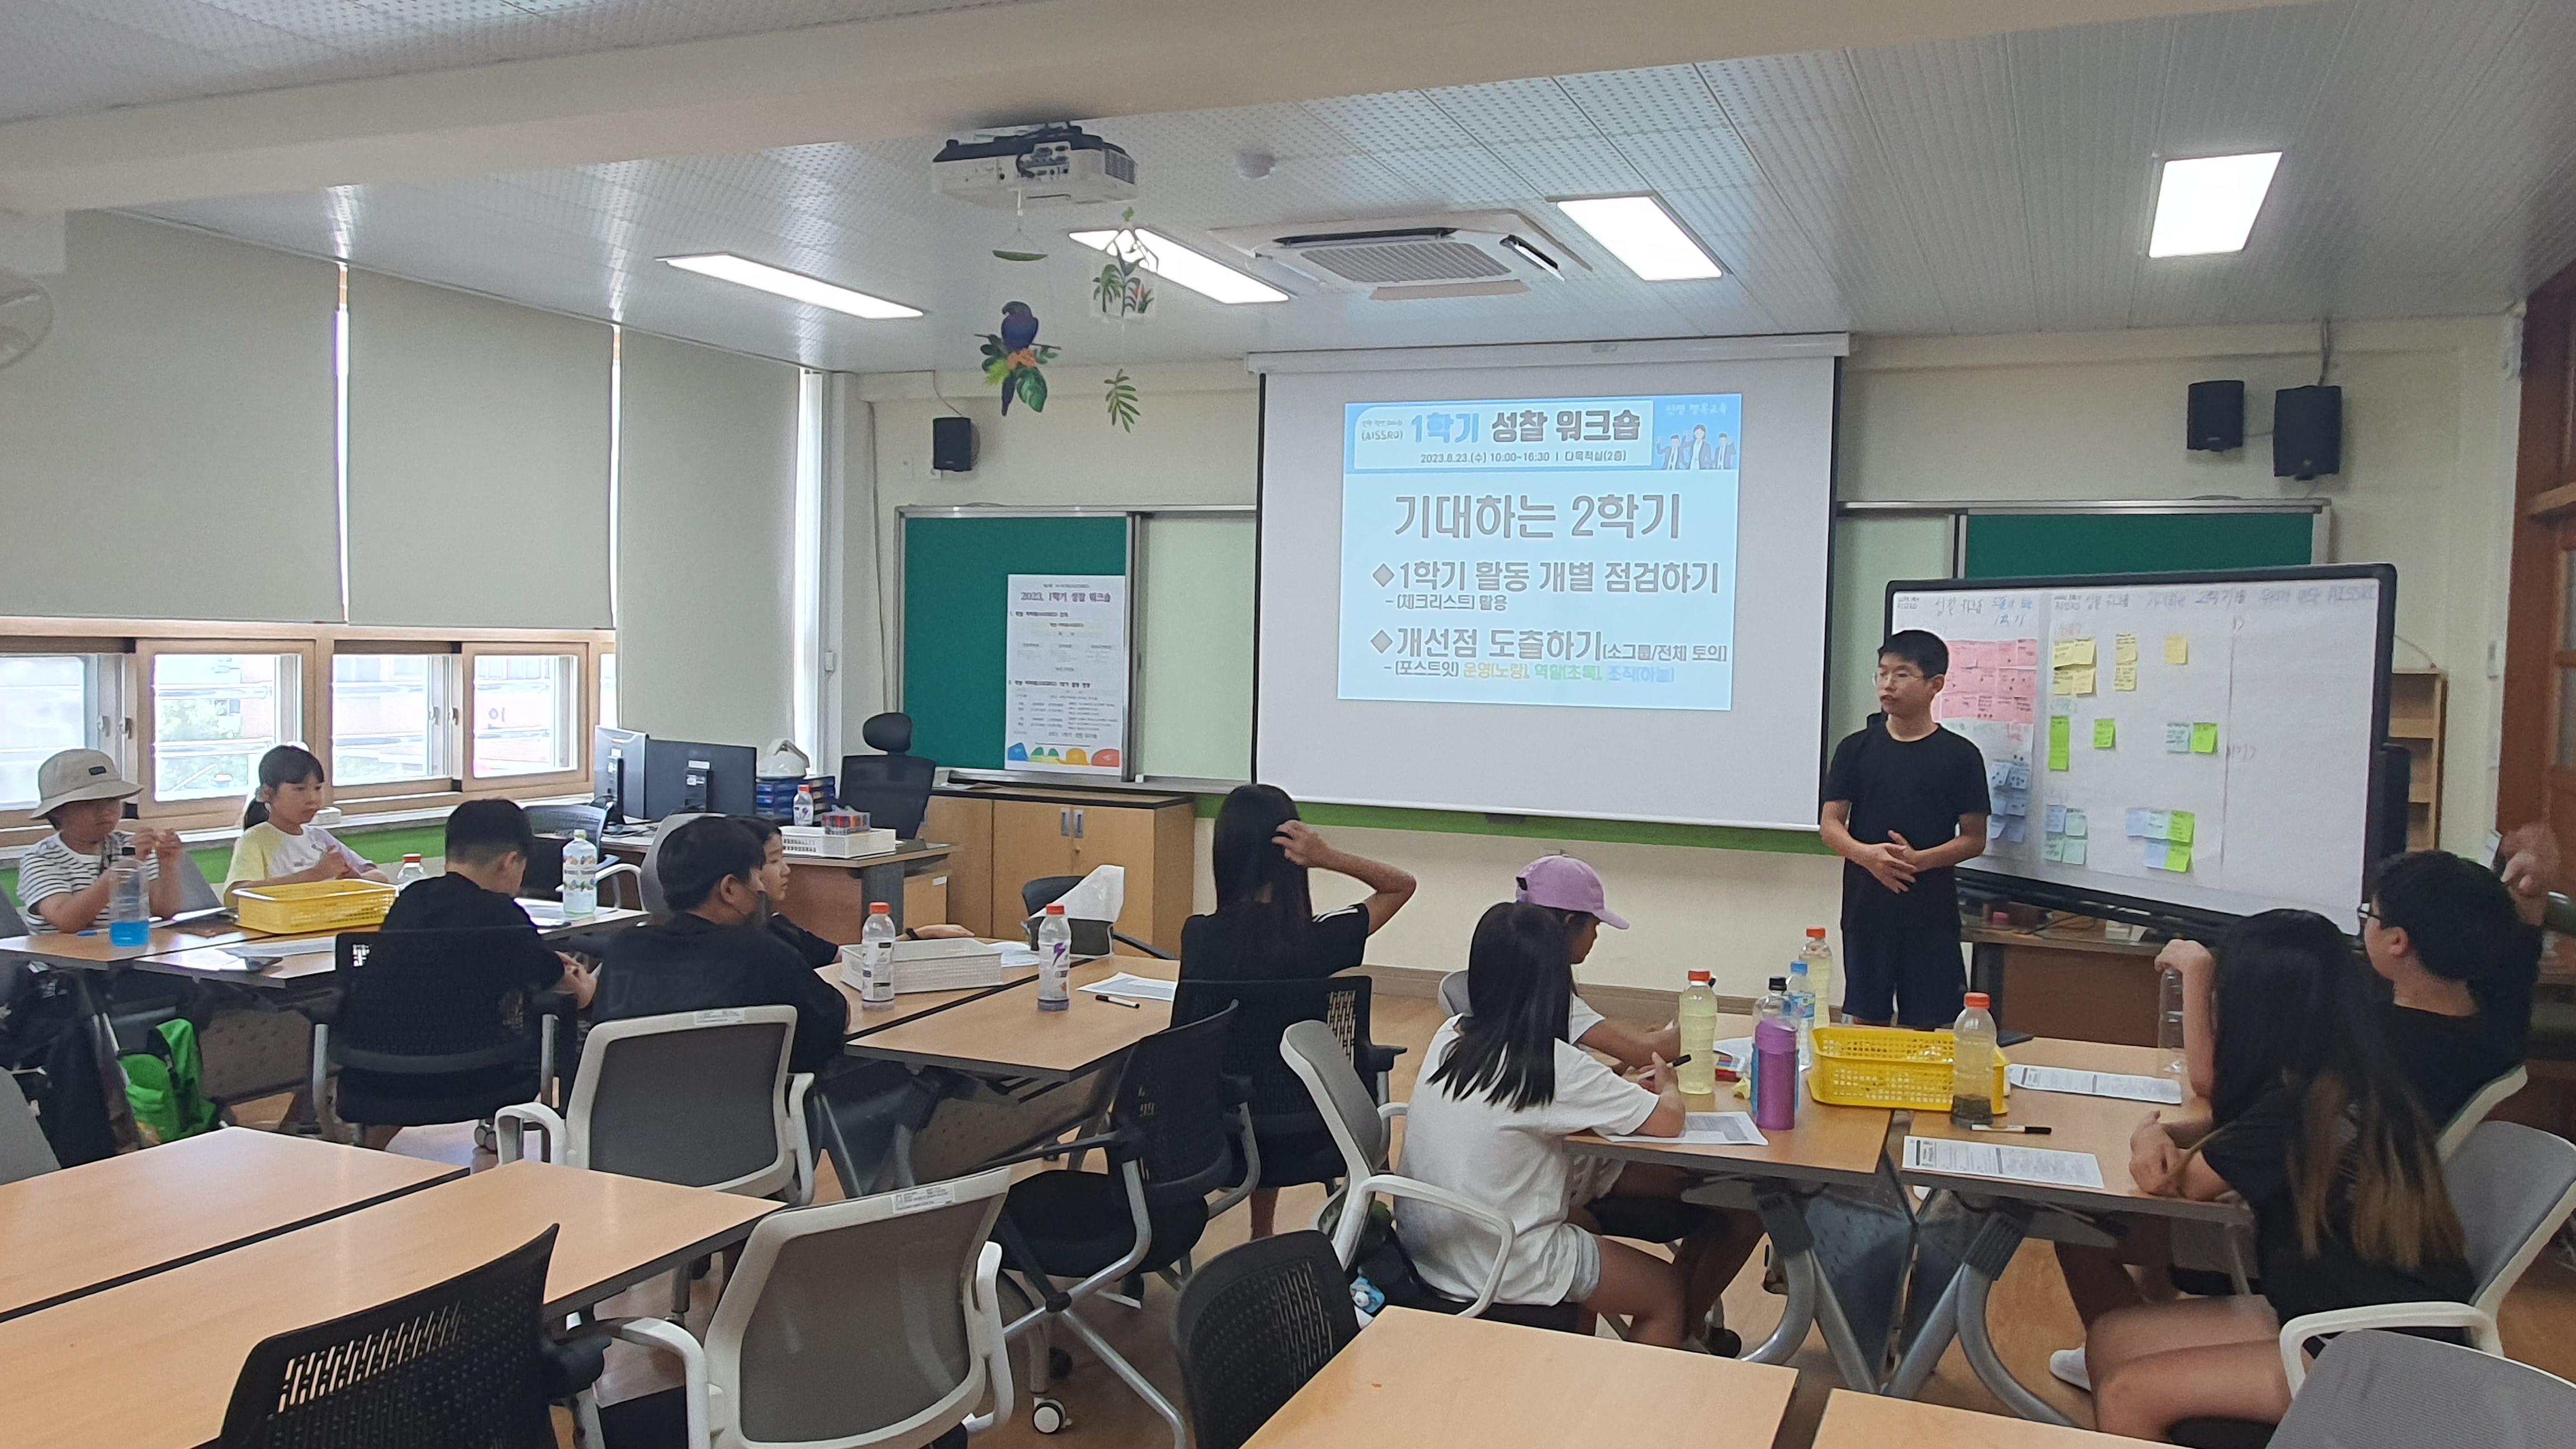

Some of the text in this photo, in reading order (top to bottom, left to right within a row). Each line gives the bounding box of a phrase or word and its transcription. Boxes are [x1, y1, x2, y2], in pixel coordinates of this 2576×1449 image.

[1411, 409, 1640, 443] 1학기 성찰 워크숍
[1394, 493, 1680, 539] 기대하는 2학기
[1399, 561, 1719, 594] 1학기 활동 개별 점검하기
[1396, 627, 1478, 659] 개선점
